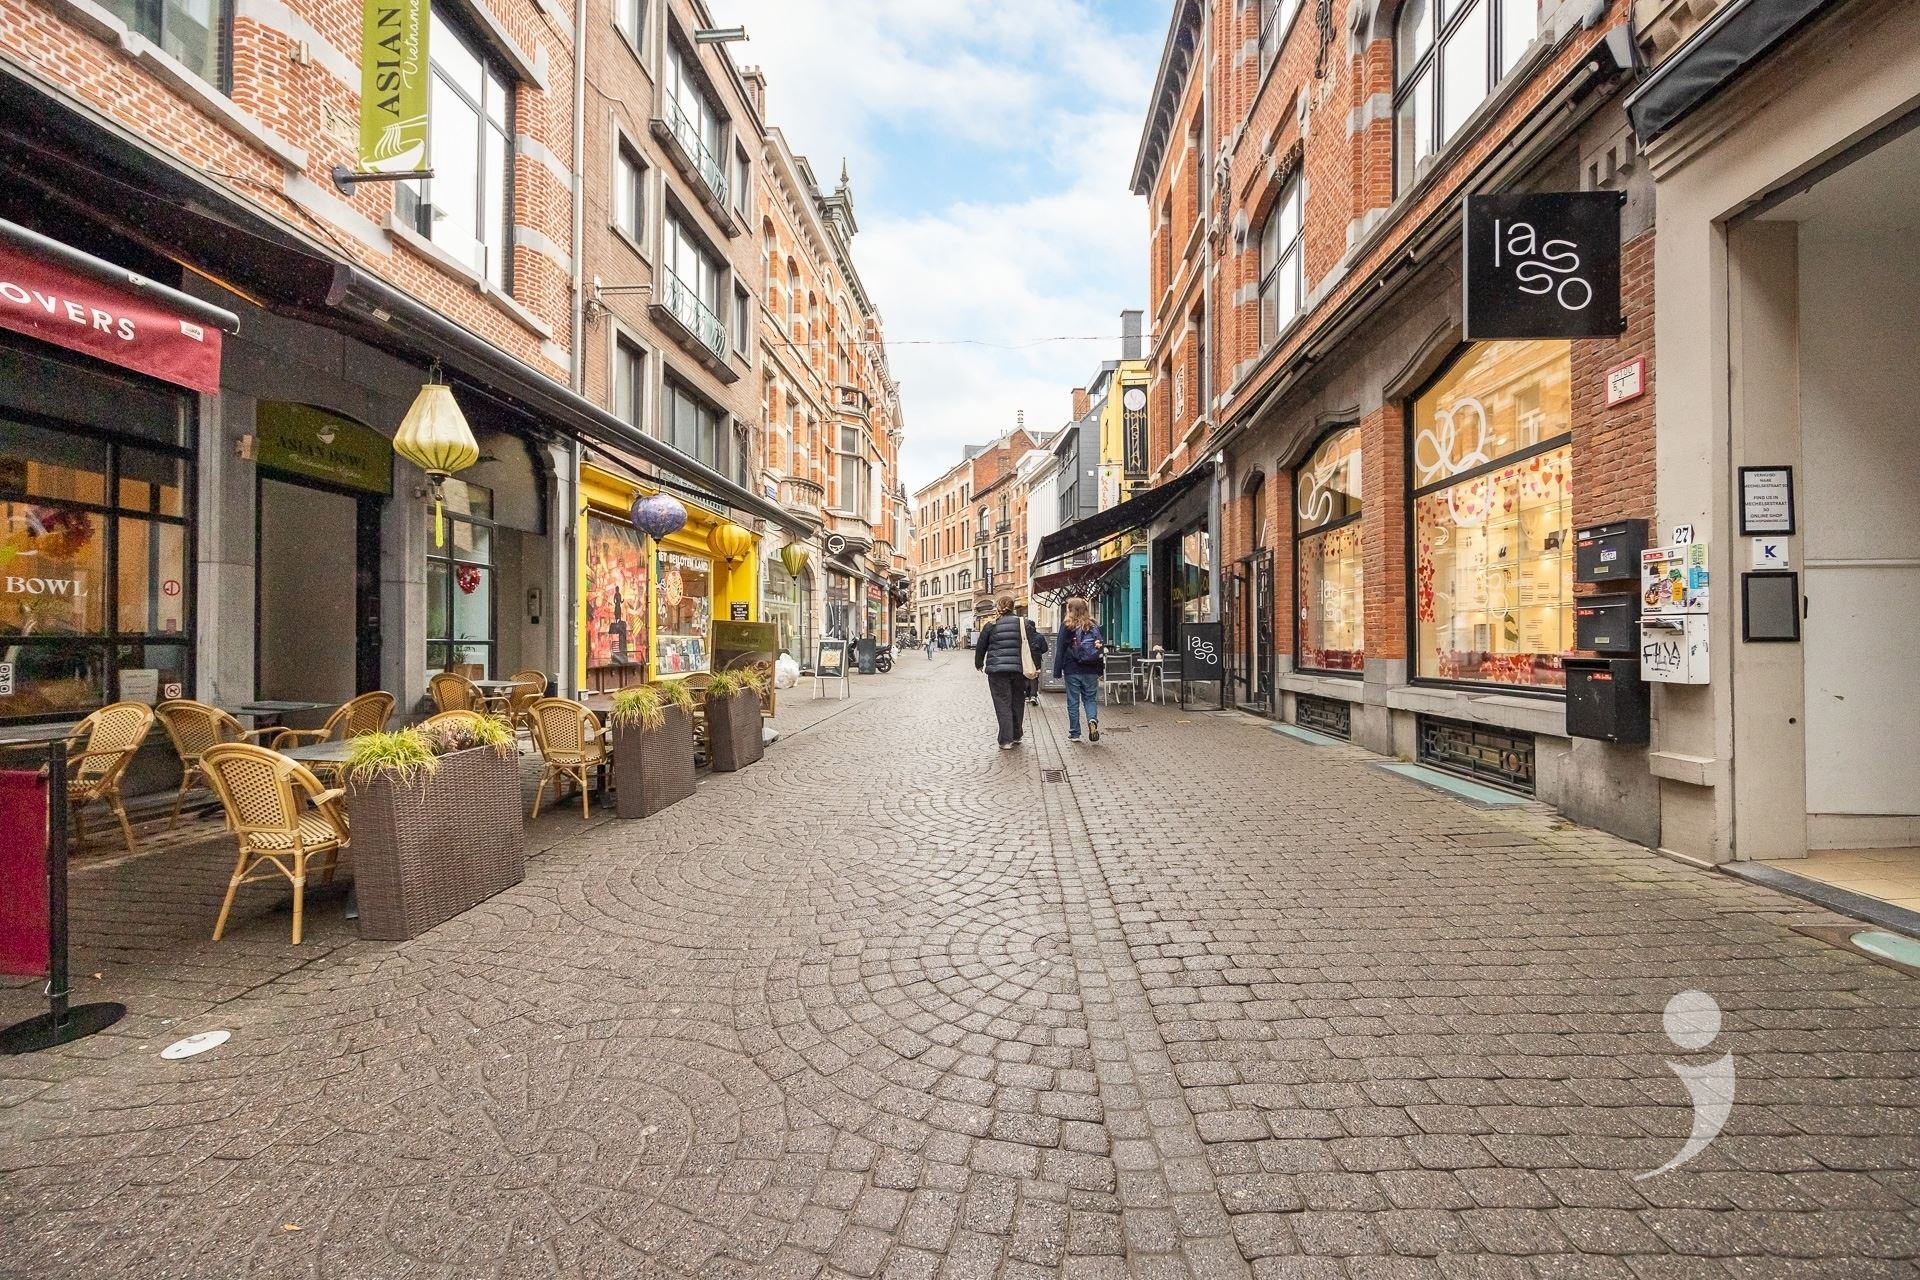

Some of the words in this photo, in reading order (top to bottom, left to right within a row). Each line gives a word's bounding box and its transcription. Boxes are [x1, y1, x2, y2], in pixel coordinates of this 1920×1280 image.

[376, 7, 402, 118] ASIAN
[1495, 219, 1592, 311] lasso
[0, 281, 135, 341] OVERS
[1675, 527, 1689, 544] 27
[5, 576, 88, 597] BOWL
[1187, 634, 1218, 665] lasso
